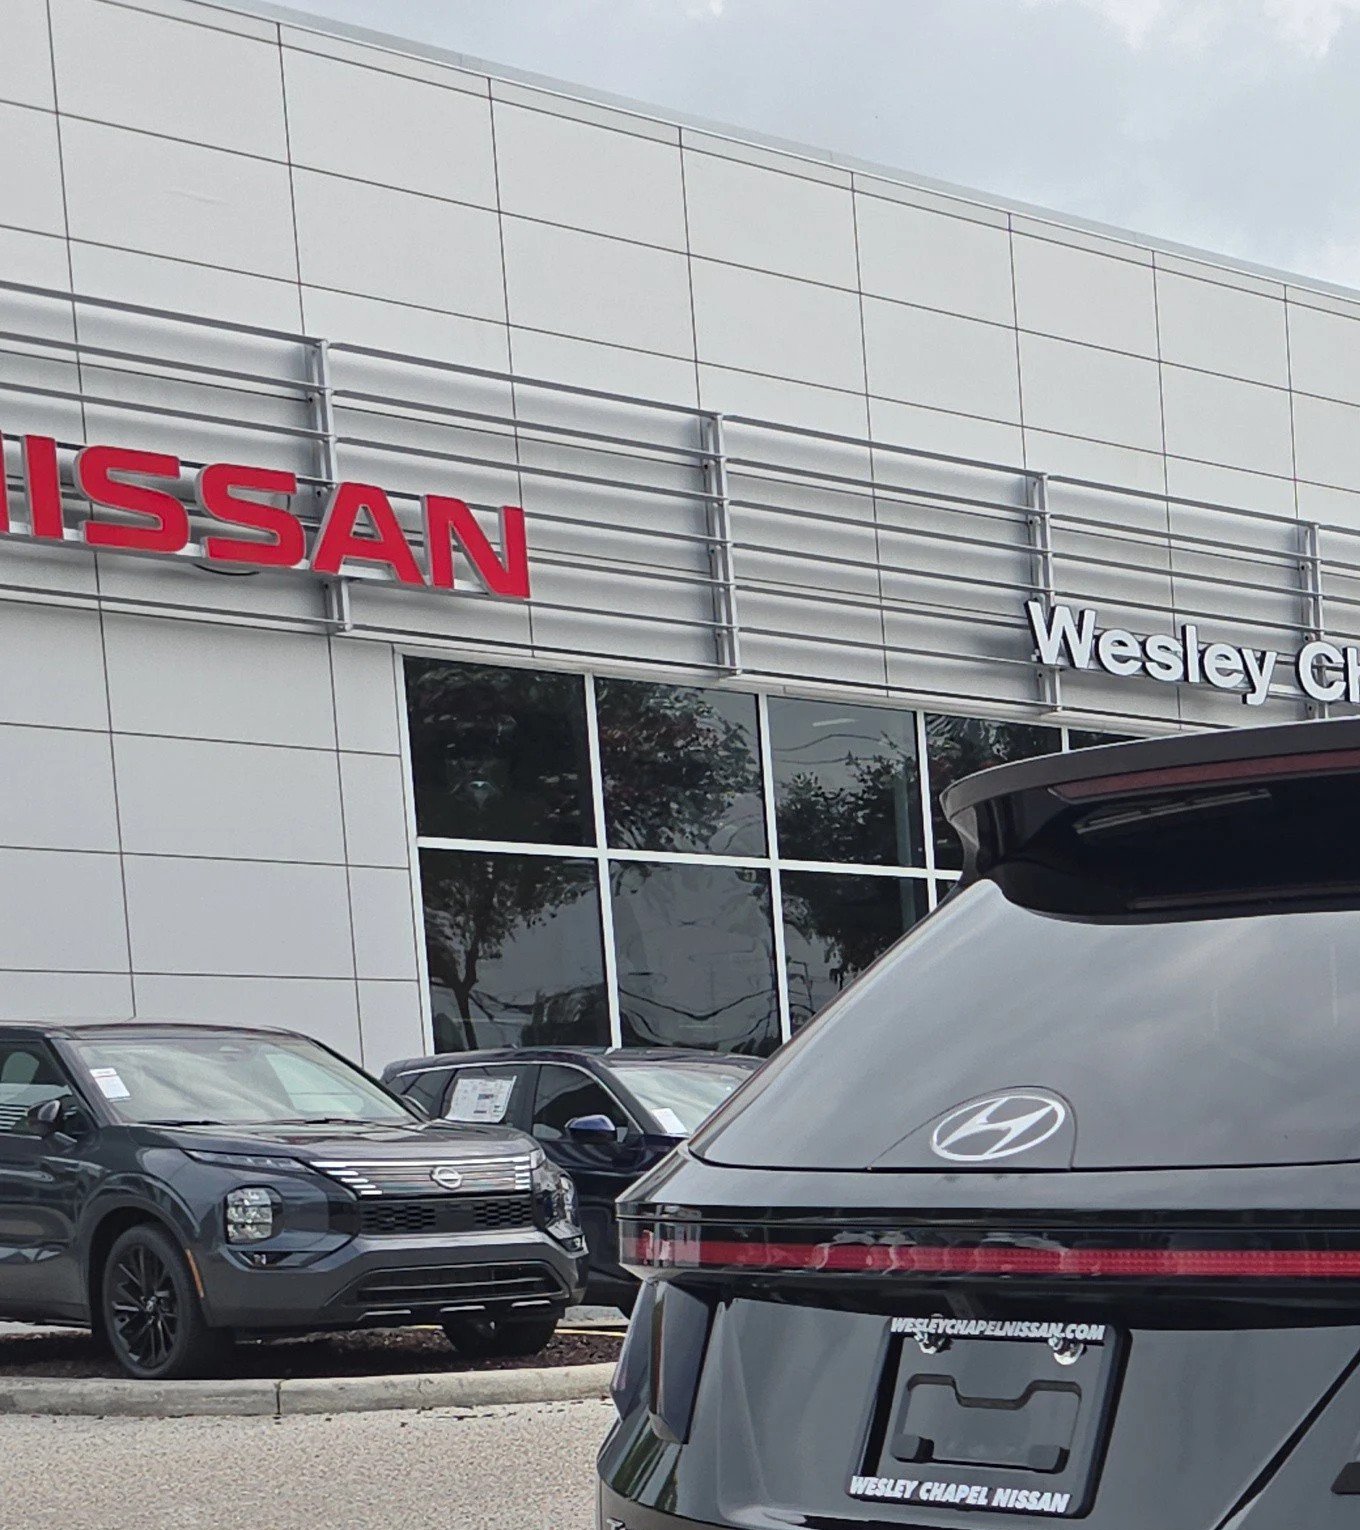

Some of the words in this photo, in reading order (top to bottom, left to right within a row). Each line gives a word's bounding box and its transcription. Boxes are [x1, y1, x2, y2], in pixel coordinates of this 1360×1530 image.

[1025, 600, 1278, 705] Wesley
[891, 1317, 1105, 1340] WESLEYCHAPELNISSAN.COM
[850, 1476, 919, 1498] WESLEY
[919, 1482, 989, 1505] CHAPEL
[991, 1488, 1070, 1513] NISSAN
